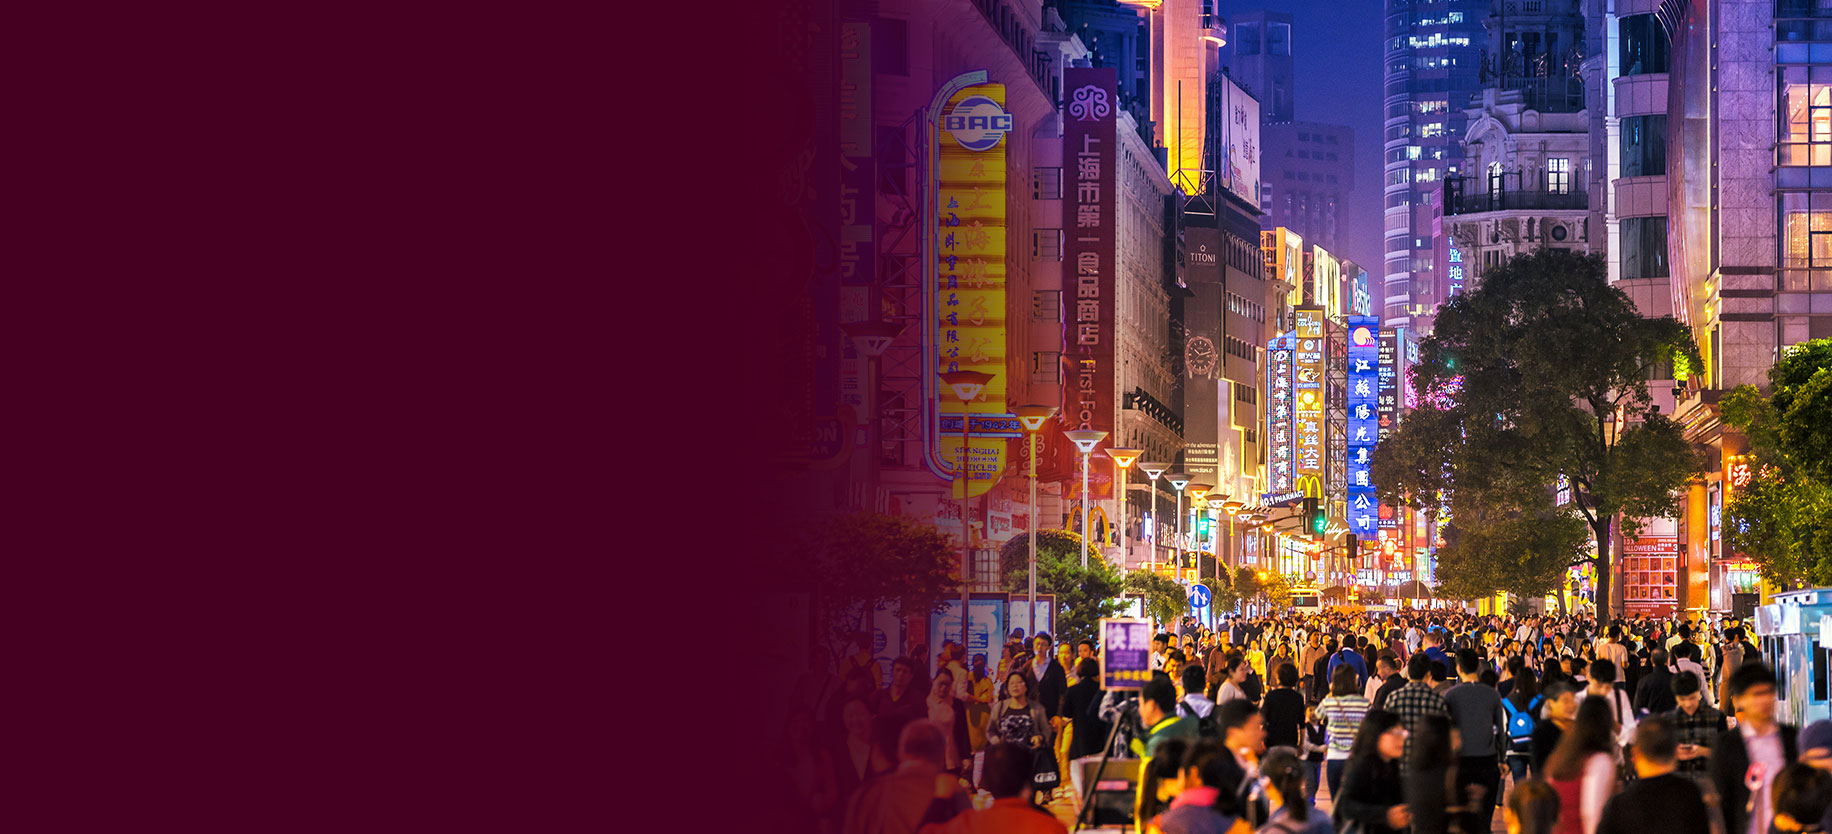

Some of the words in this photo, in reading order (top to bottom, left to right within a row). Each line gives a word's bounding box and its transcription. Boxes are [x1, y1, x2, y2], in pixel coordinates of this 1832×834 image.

[946, 115, 1011, 131] BAC
[1077, 134, 1100, 345] 上海市第一食品商店
[1190, 253, 1216, 262] TITONI
[1079, 360, 1096, 395] First
[1079, 401, 1096, 430] Foo
[1303, 421, 1320, 469] 真丝大王
[1260, 496, 1275, 508] NO.1
[1275, 490, 1304, 503] PHARMACY
